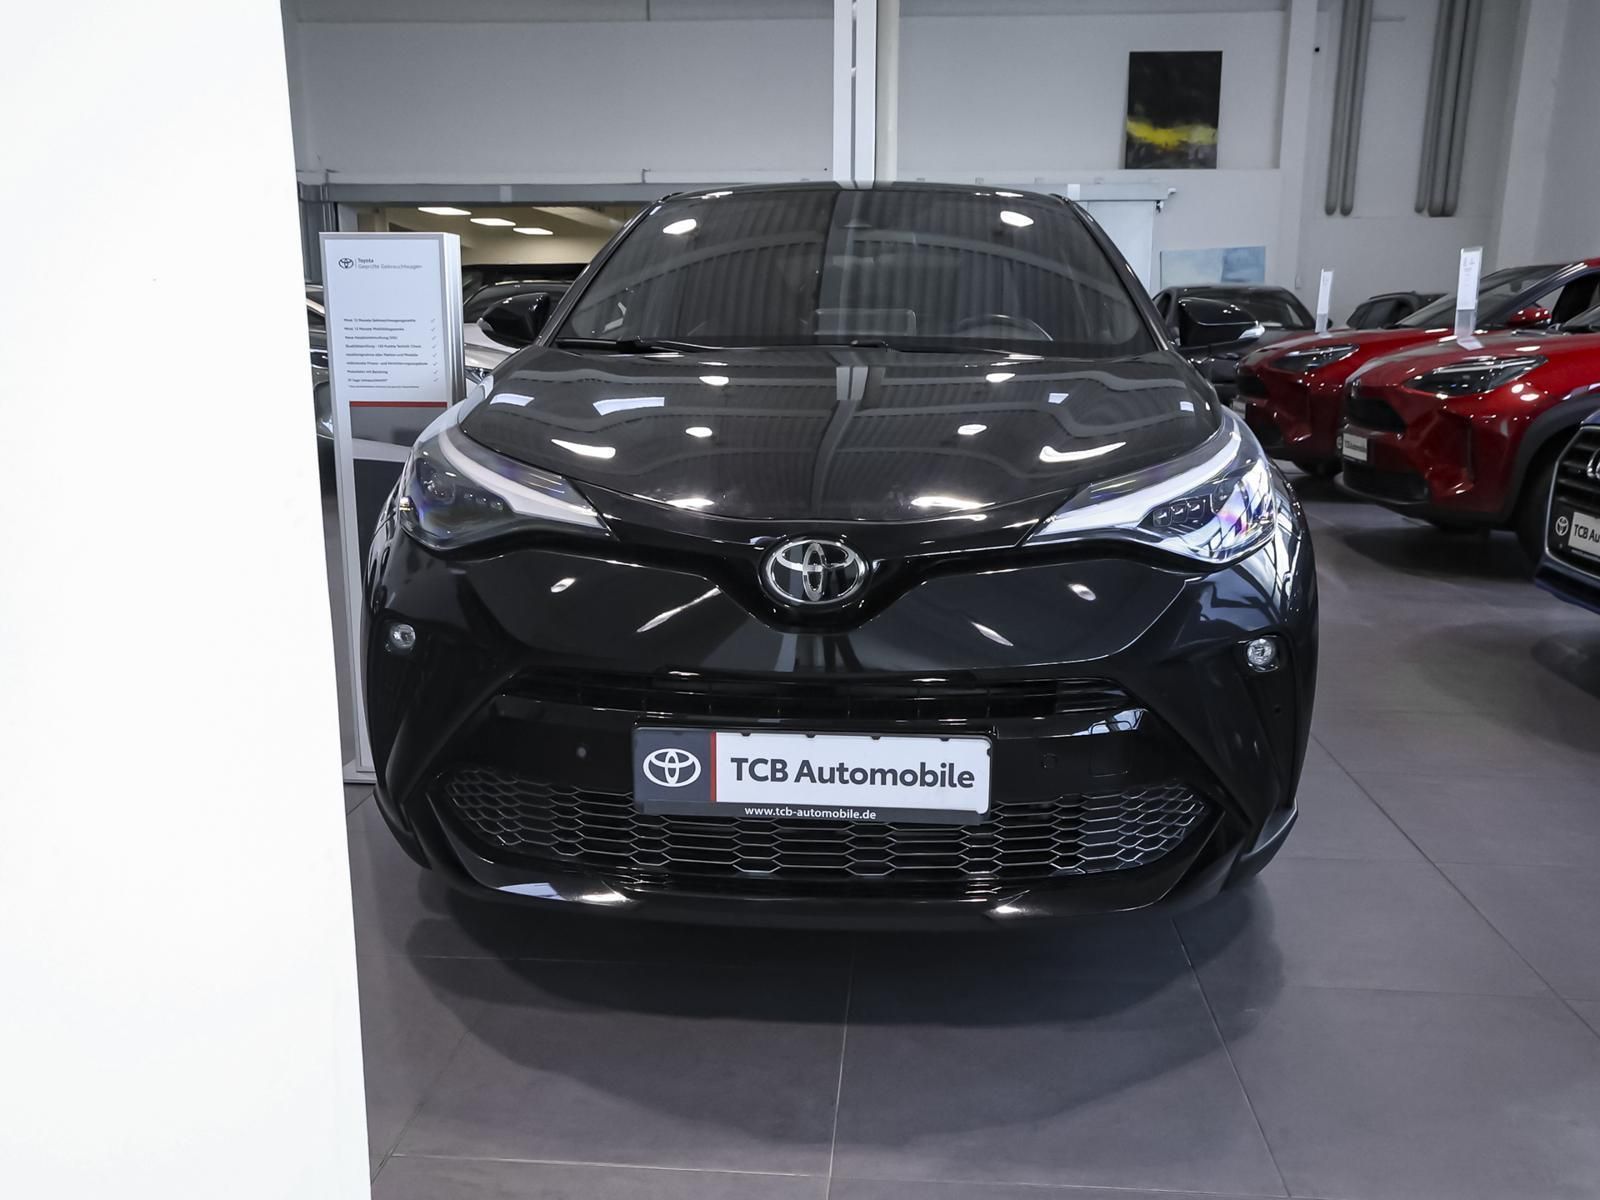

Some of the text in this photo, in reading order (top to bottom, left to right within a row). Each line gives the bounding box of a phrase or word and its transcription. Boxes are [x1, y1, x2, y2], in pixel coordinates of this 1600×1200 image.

[1574, 523, 1588, 539] TCB
[730, 757, 976, 789] TCB Automobile
[744, 807, 877, 821] www.tcb-automobile.de
